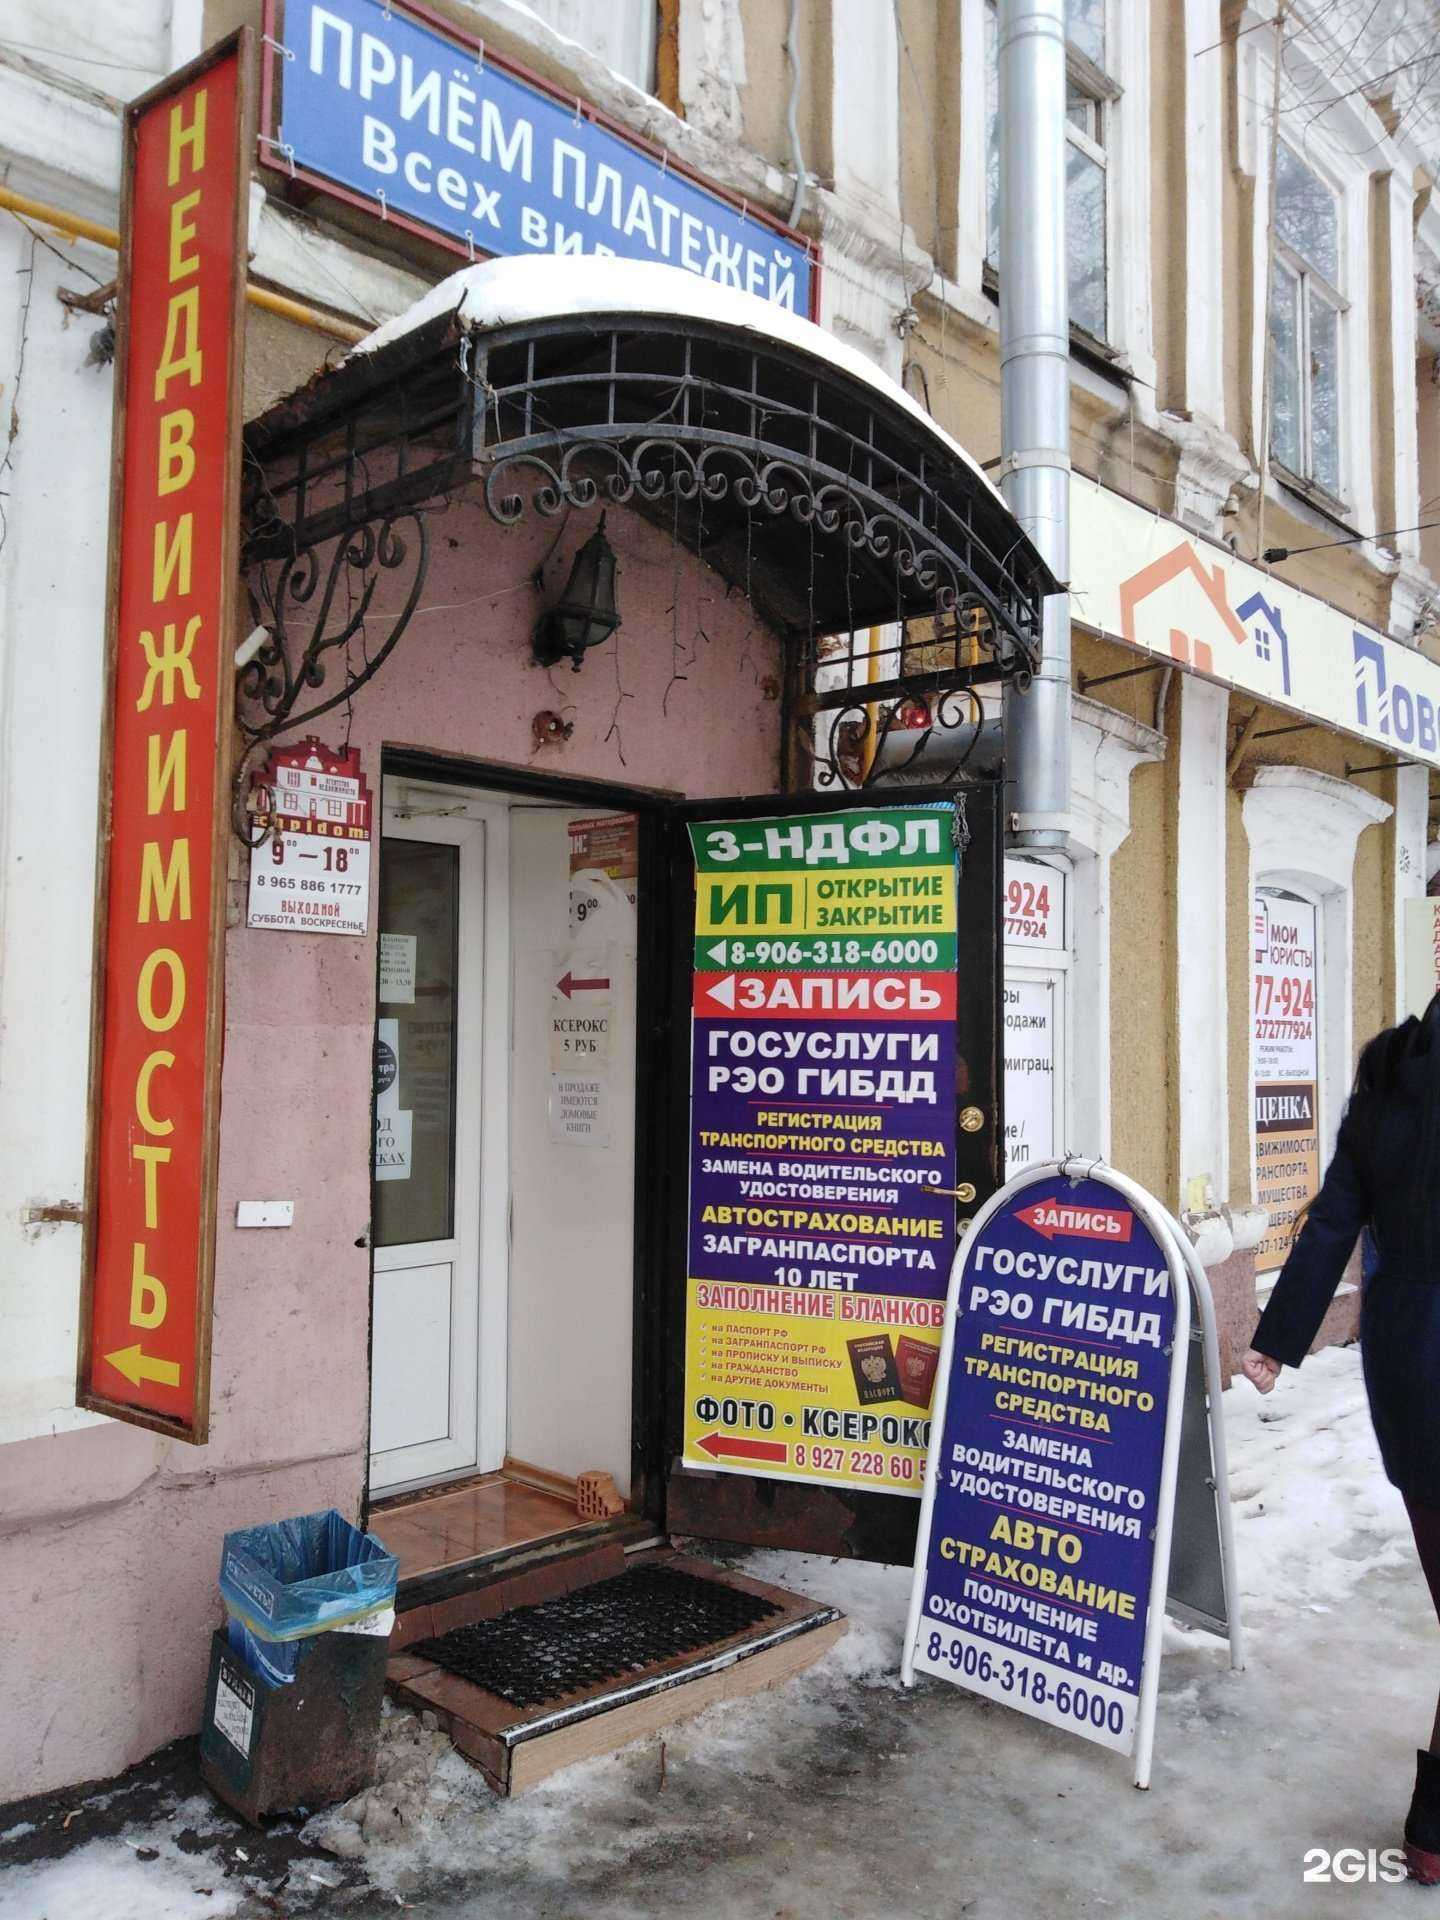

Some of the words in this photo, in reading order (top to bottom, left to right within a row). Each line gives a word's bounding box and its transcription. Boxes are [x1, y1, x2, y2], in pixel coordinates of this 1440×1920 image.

[308, 5, 534, 183] ПРИЁМ
[552, 138, 796, 310] ПЛАТЕЖЕЙ
[362, 115, 501, 228] Всех
[521, 206, 616, 257] ви
[1352, 629, 1440, 753] ПОВ
[130, 89, 207, 1329] НЕДВИЖИМОСТЬ
[706, 819, 941, 864] 3-НДФЛ
[257, 875, 266, 887] 8
[270, 876, 296, 889] 965
[300, 879, 326, 892] 886
[330, 883, 362, 895] 1777
[816, 876, 943, 899] ОТКРЫТИЕ
[281, 900, 341, 917] ВЫХОДНОЙ
[710, 883, 793, 925] ИП
[816, 905, 943, 927] ЗАКРЫТИЕ
[251, 914, 296, 924] СУББОТА
[301, 917, 364, 930] ВОСКРЕСЕНЬЕ
[1271, 924, 1298, 945] МОИ
[731, 940, 938, 965] 8-906-318-6000
[1270, 945, 1313, 968] ЮРИСТЫ
[739, 978, 942, 1010] ЗАПИСЬ
[553, 1018, 608, 1033] КСЕРОКС
[1004, 1014, 1046, 1031] одажи
[564, 1038, 570, 1052] 5
[575, 1039, 597, 1053] РУБ
[708, 1030, 939, 1061] ГОСУСЛУГИ
[708, 1066, 785, 1094] РЭО
[798, 1069, 937, 1104] ГИБДД
[757, 1111, 882, 1132] РЕГИСТРАЦИЯ
[1256, 1095, 1311, 1127] ЦЕНКА
[376, 1152, 406, 1164] КАХ
[700, 1131, 846, 1153] ТРАНСПОРТНОГО
[851, 1139, 946, 1158] СРЕДСТВА
[1011, 1144, 1029, 1162] ИП
[702, 1158, 774, 1176] ЗАМЕНА
[778, 1163, 942, 1185] ВОДИТЕЛЬСКОГО
[740, 1181, 899, 1204] УДОСТОВЕРЕНИЯ
[702, 1205, 944, 1239] АВТОСТРАХОВАНИЕ
[1033, 1208, 1122, 1234] ЗАПИСЬ
[703, 1234, 937, 1270] ЗАГРАНПАСПОРТА
[774, 1267, 801, 1287] 10
[808, 1270, 859, 1291] ЛЕТ
[974, 1246, 1170, 1298] ГОСУСЛУГИ
[698, 1284, 834, 1318] ЗАПОЛНЕНИЕ
[840, 1296, 945, 1327] БЛАНКОВ
[969, 1286, 1034, 1320] РЭО
[1042, 1298, 1162, 1349] ГИБДД
[726, 1325, 771, 1336] ПАСПОРТ
[773, 1329, 788, 1338] РФ
[726, 1337, 809, 1353] ЗАГРАНПАСПОРТ
[811, 1345, 826, 1354] РФ
[726, 1350, 780, 1363] ПРОПИСКУ
[791, 1356, 842, 1368] ВЫПИСКУ
[726, 1362, 799, 1377] ГРАЖДАНСТВО
[981, 1333, 1140, 1380] РЕГИСТРАЦИЯ
[725, 1375, 763, 1386] ДРУГИЕ
[764, 1379, 829, 1393] ДОКУМЕНТЫ
[964, 1356, 1154, 1413] ТРАНСПОРТНОГО
[696, 1397, 774, 1430] ФОТО
[995, 1391, 1111, 1434] СРЕДСТВА
[795, 1445, 805, 1466] 8
[812, 1448, 845, 1471] 927
[851, 1452, 884, 1476] 228
[890, 1456, 913, 1480] 60
[1002, 1429, 1094, 1468] ЗАМЕНА
[952, 1443, 1146, 1510] ВОДИТЕЛЬСКОГО
[950, 1469, 1142, 1540] УДОСТОВЕРЕНИЯ
[990, 1515, 1083, 1565] АВТО
[940, 1537, 1137, 1621] СТРАХОВАНИЕ
[963, 1579, 1099, 1642] ПОЛУЧЕНИЕ
[929, 1595, 1071, 1665] ОХОТБИЛЕТА
[927, 1632, 1124, 1735] 8-906-318-6000
